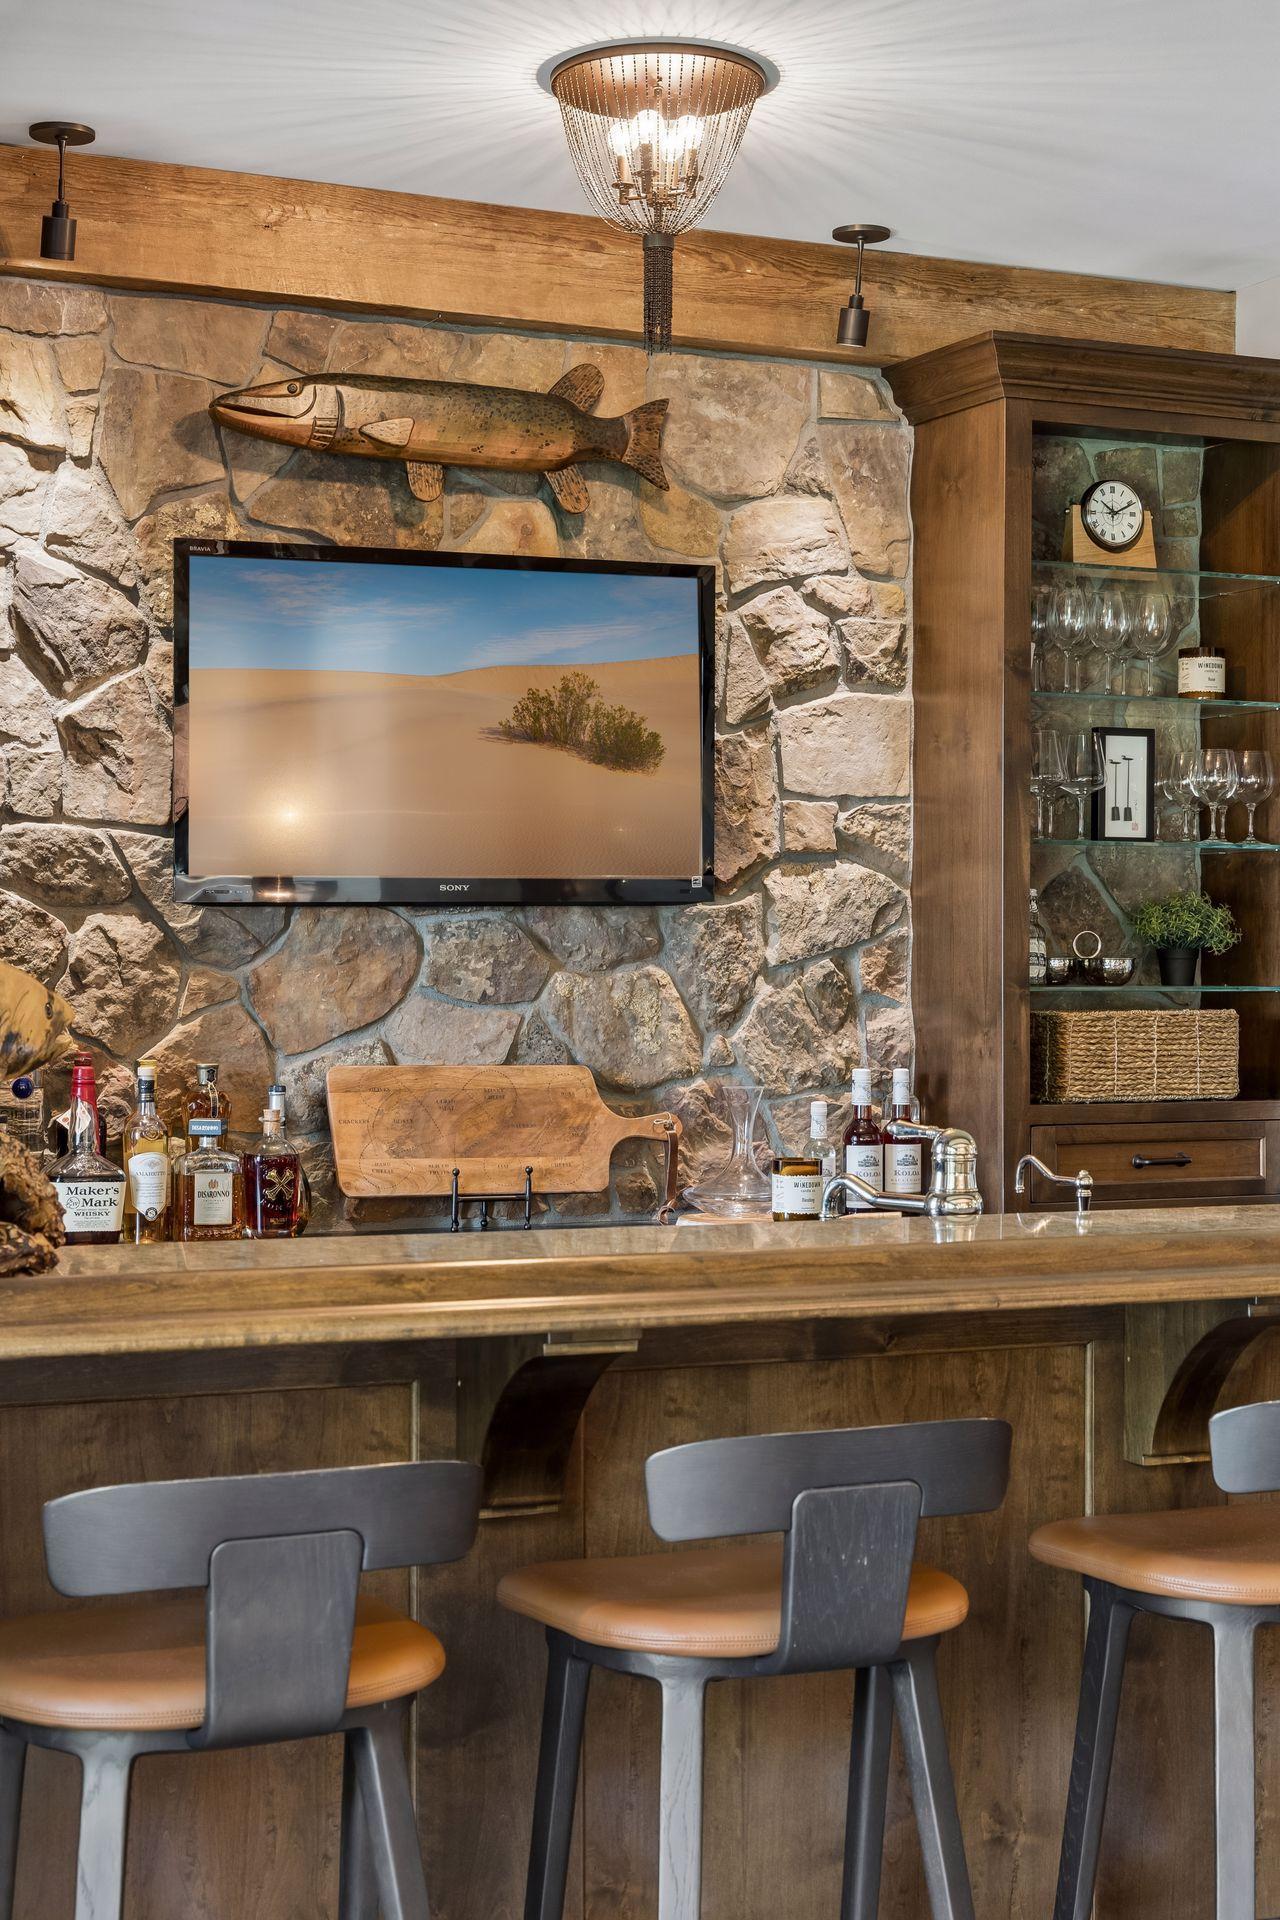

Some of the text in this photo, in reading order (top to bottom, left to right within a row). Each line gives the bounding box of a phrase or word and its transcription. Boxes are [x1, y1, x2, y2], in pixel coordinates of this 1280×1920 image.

[66, 1186, 120, 1196] Maker's
[197, 1190, 230, 1198] DISARONNO
[81, 1198, 118, 1207] Mark
